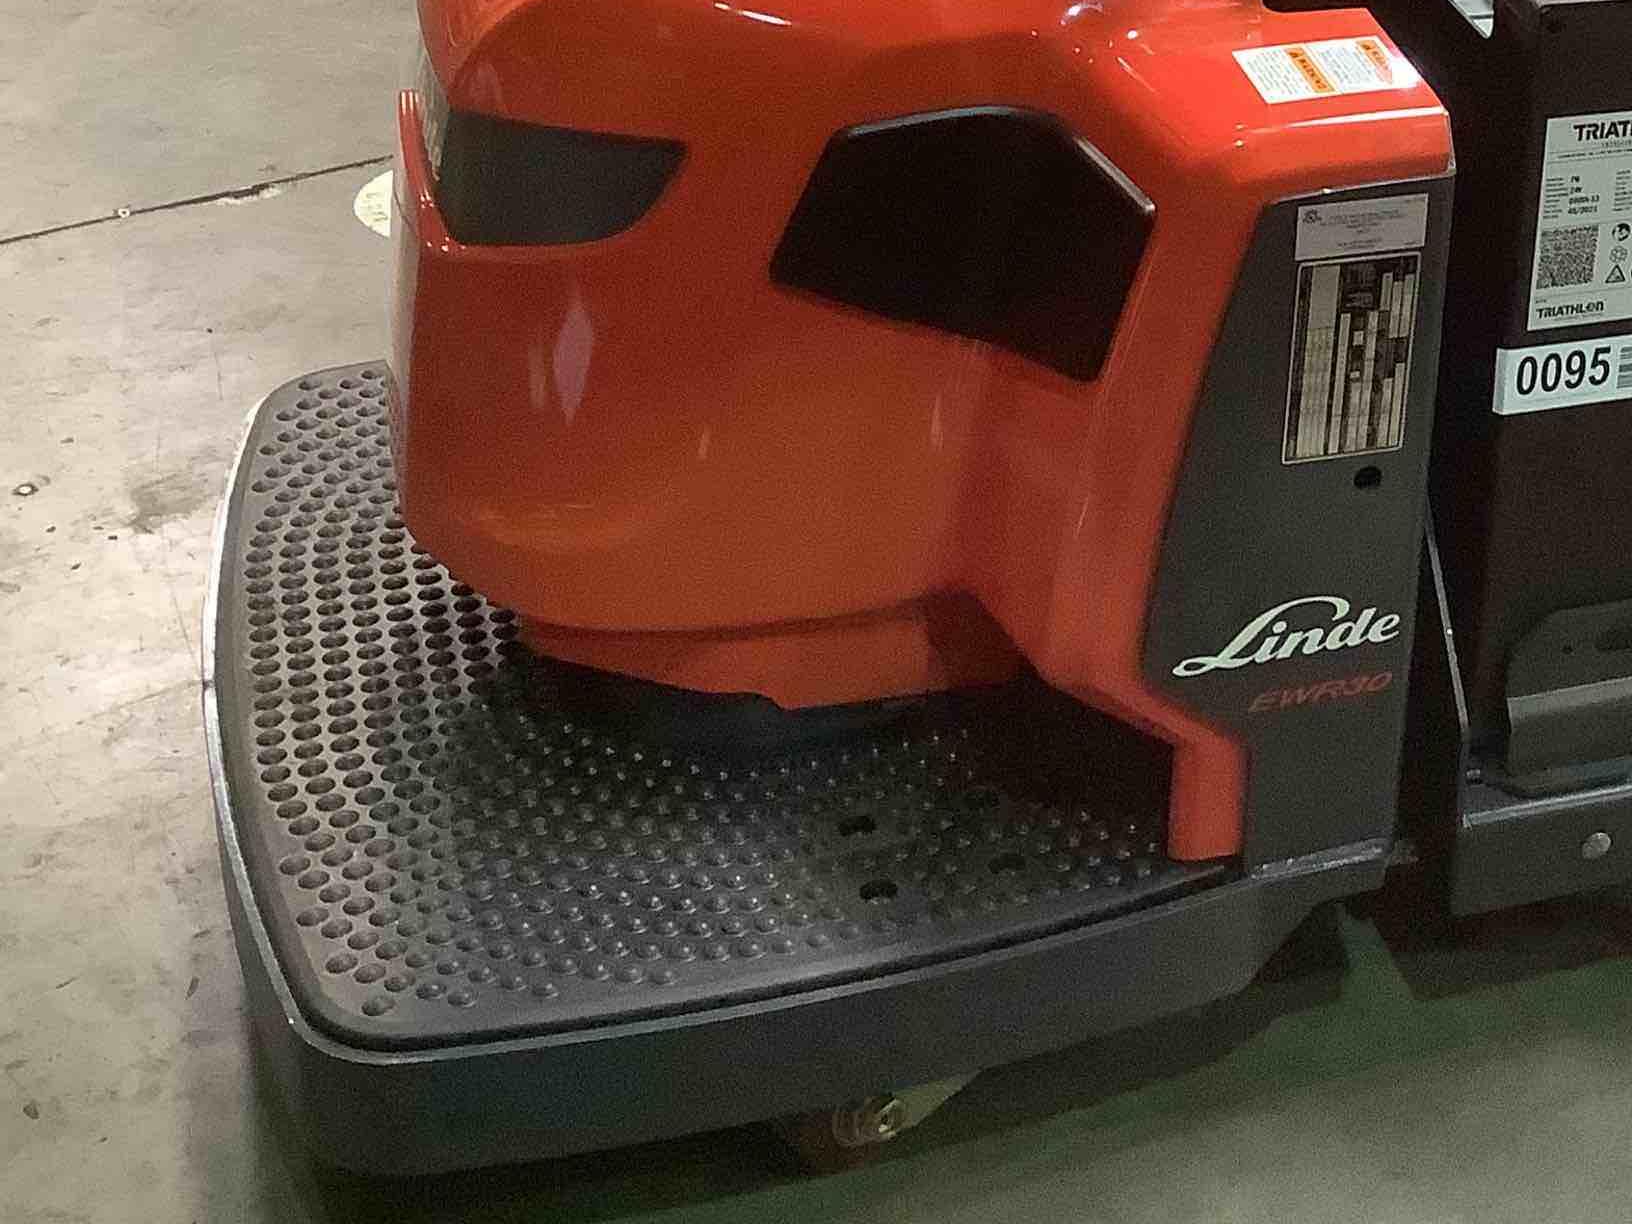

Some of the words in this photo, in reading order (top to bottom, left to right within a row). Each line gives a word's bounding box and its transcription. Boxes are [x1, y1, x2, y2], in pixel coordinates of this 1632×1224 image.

[1536, 300, 1605, 319] TRIATHLON
[1516, 345, 1612, 395] 0095
[1172, 595, 1401, 677] Linde
[1249, 671, 1394, 712] EWR30
